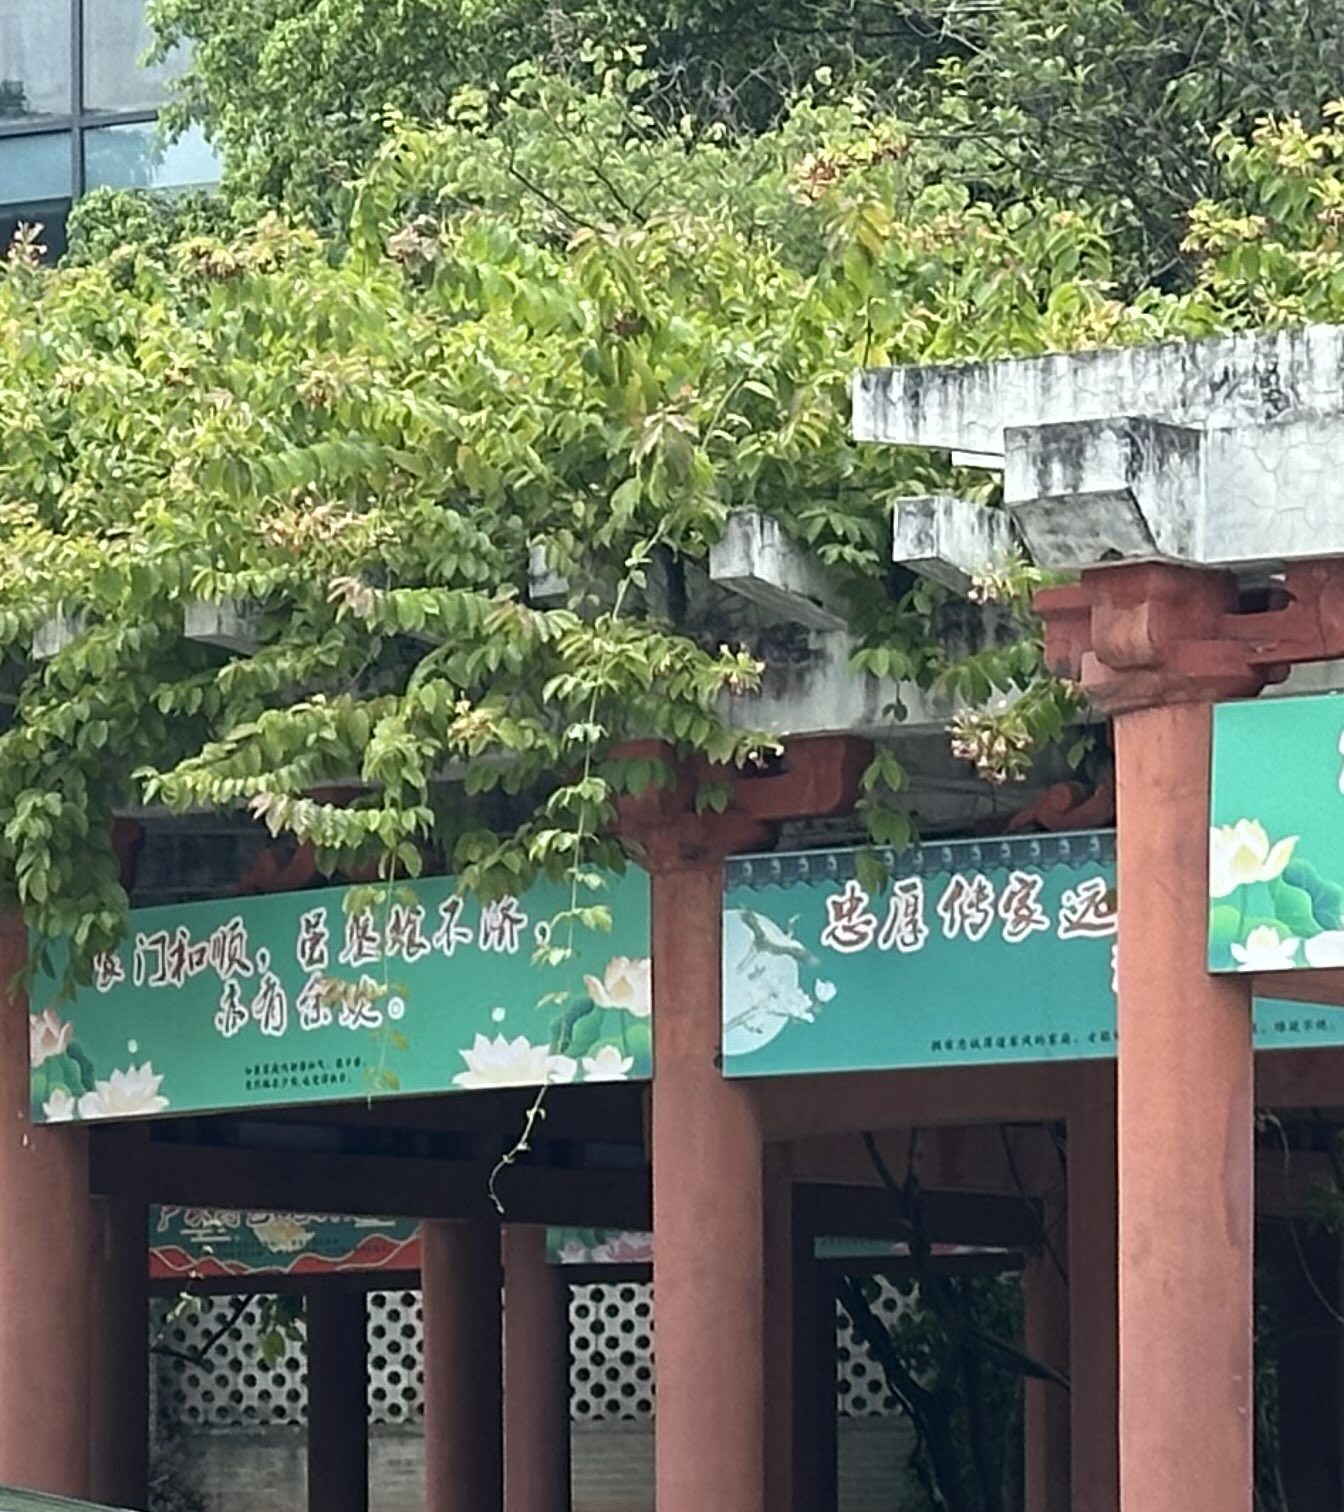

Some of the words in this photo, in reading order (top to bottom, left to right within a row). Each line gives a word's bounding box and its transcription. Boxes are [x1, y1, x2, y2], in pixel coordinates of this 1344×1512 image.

[821, 870, 1117, 953] 忠厚传家远
